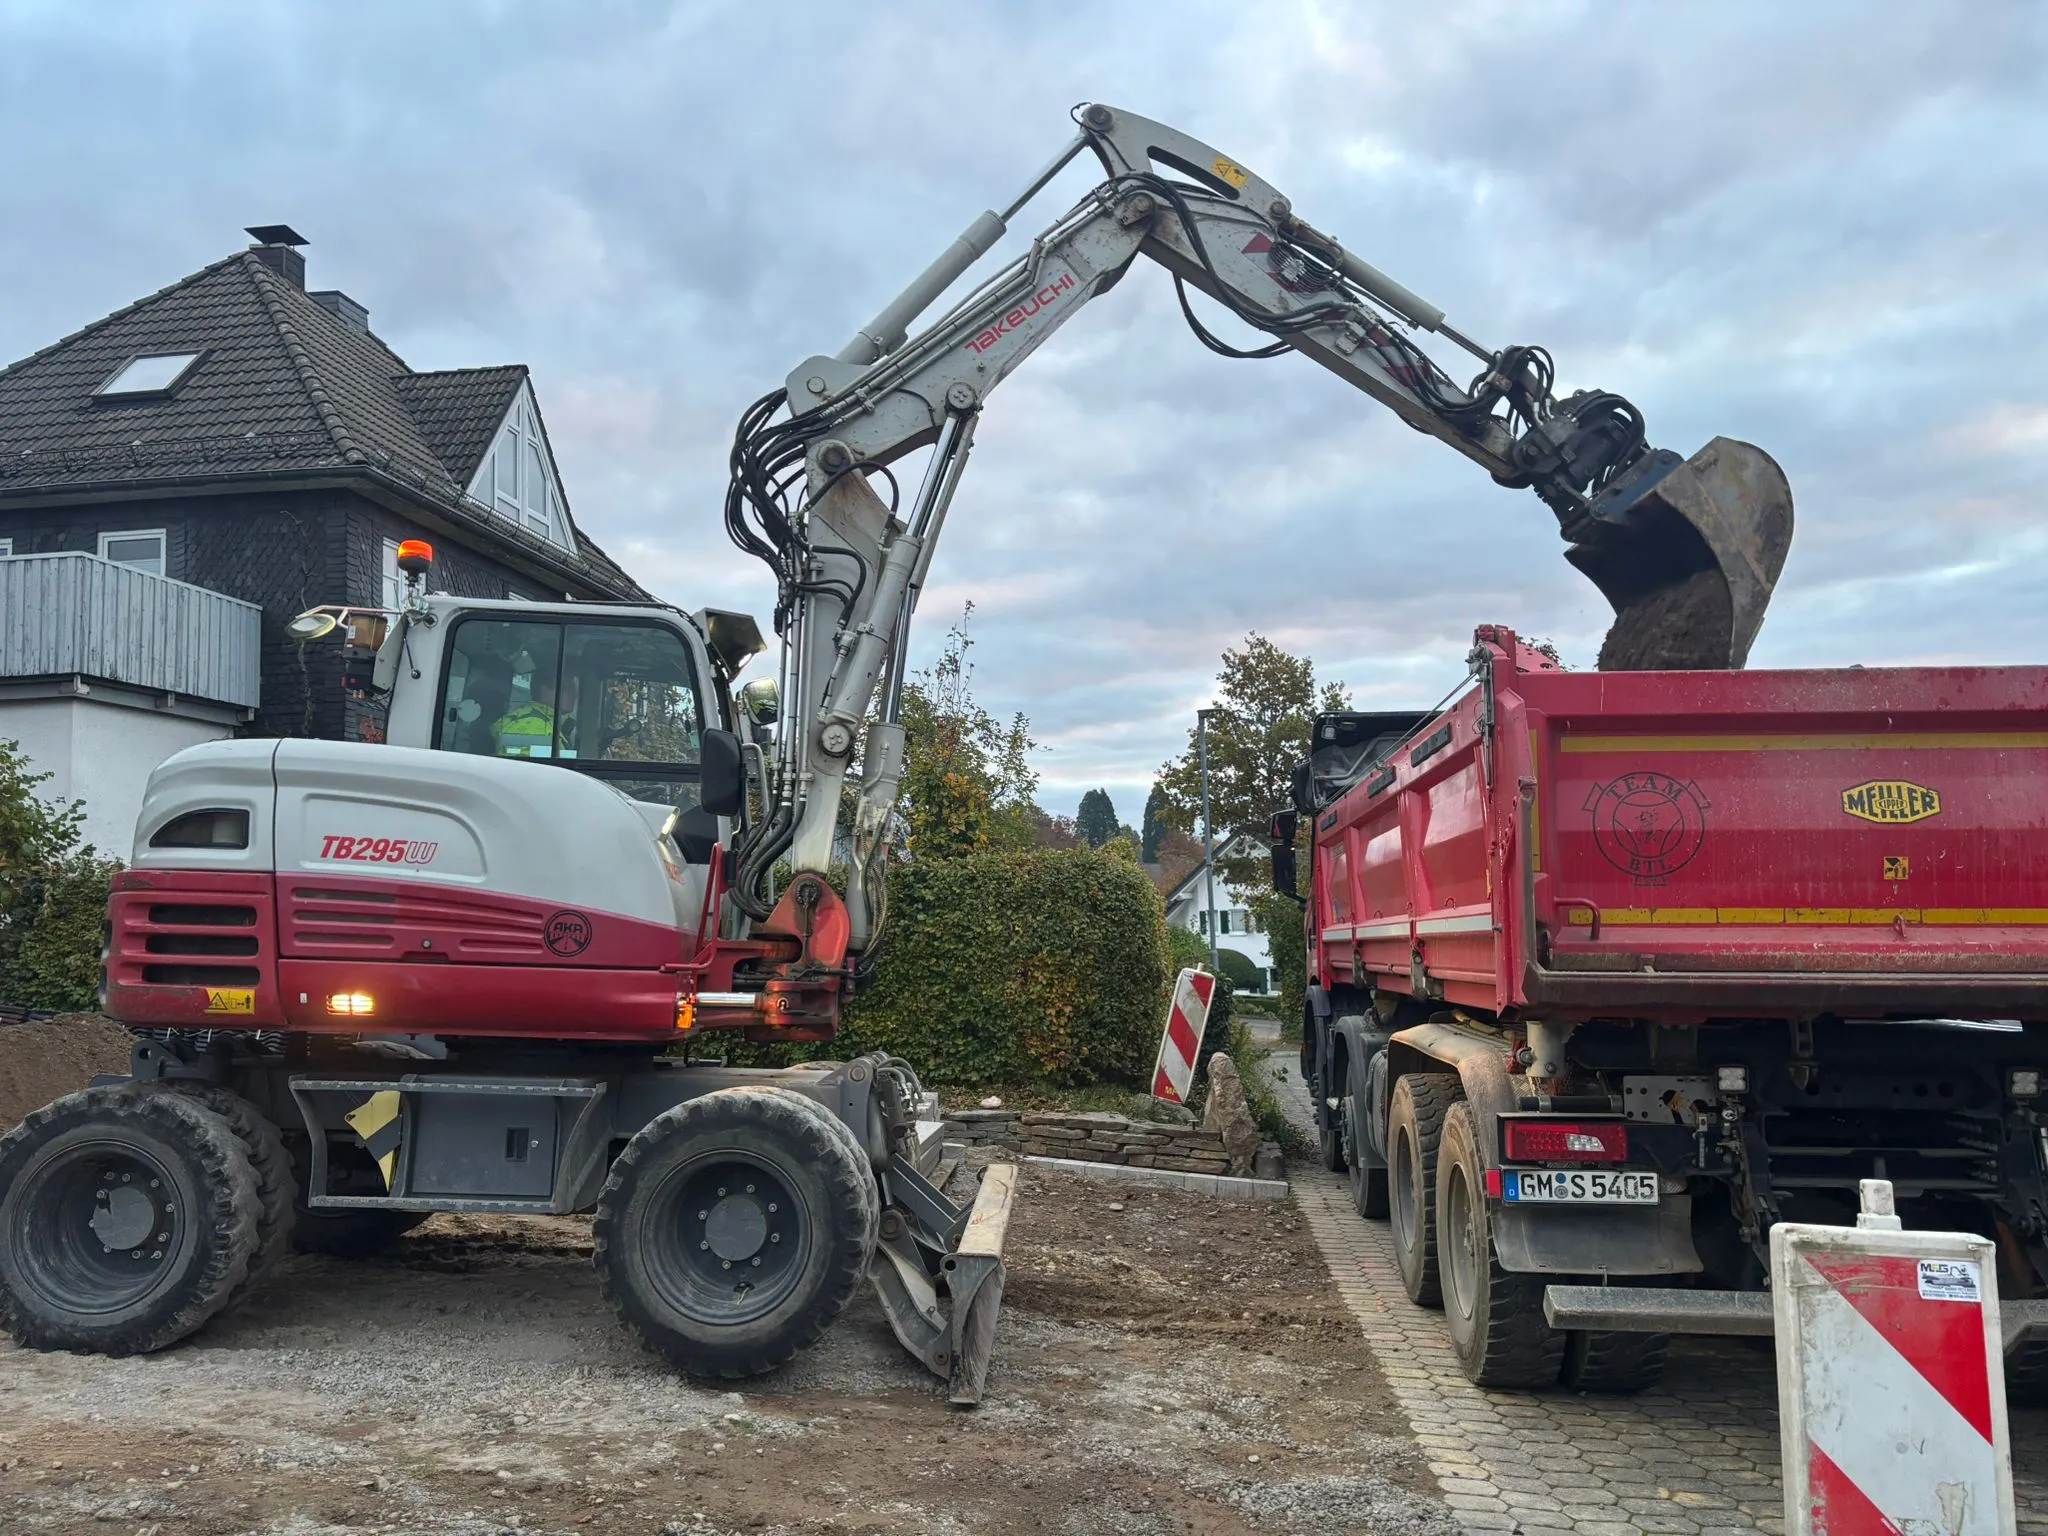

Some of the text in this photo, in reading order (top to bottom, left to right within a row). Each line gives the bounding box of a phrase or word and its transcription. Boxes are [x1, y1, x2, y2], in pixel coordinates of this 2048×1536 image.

[1606, 775, 1685, 802] TEAM
[1846, 785, 1936, 819] MEILLER
[1878, 800, 1905, 810] KIPPER
[320, 835, 438, 864] TB295W
[1520, 1174, 1553, 1198] GM
[1570, 1175, 1586, 1199] S
[1591, 1175, 1655, 1199] 5405
